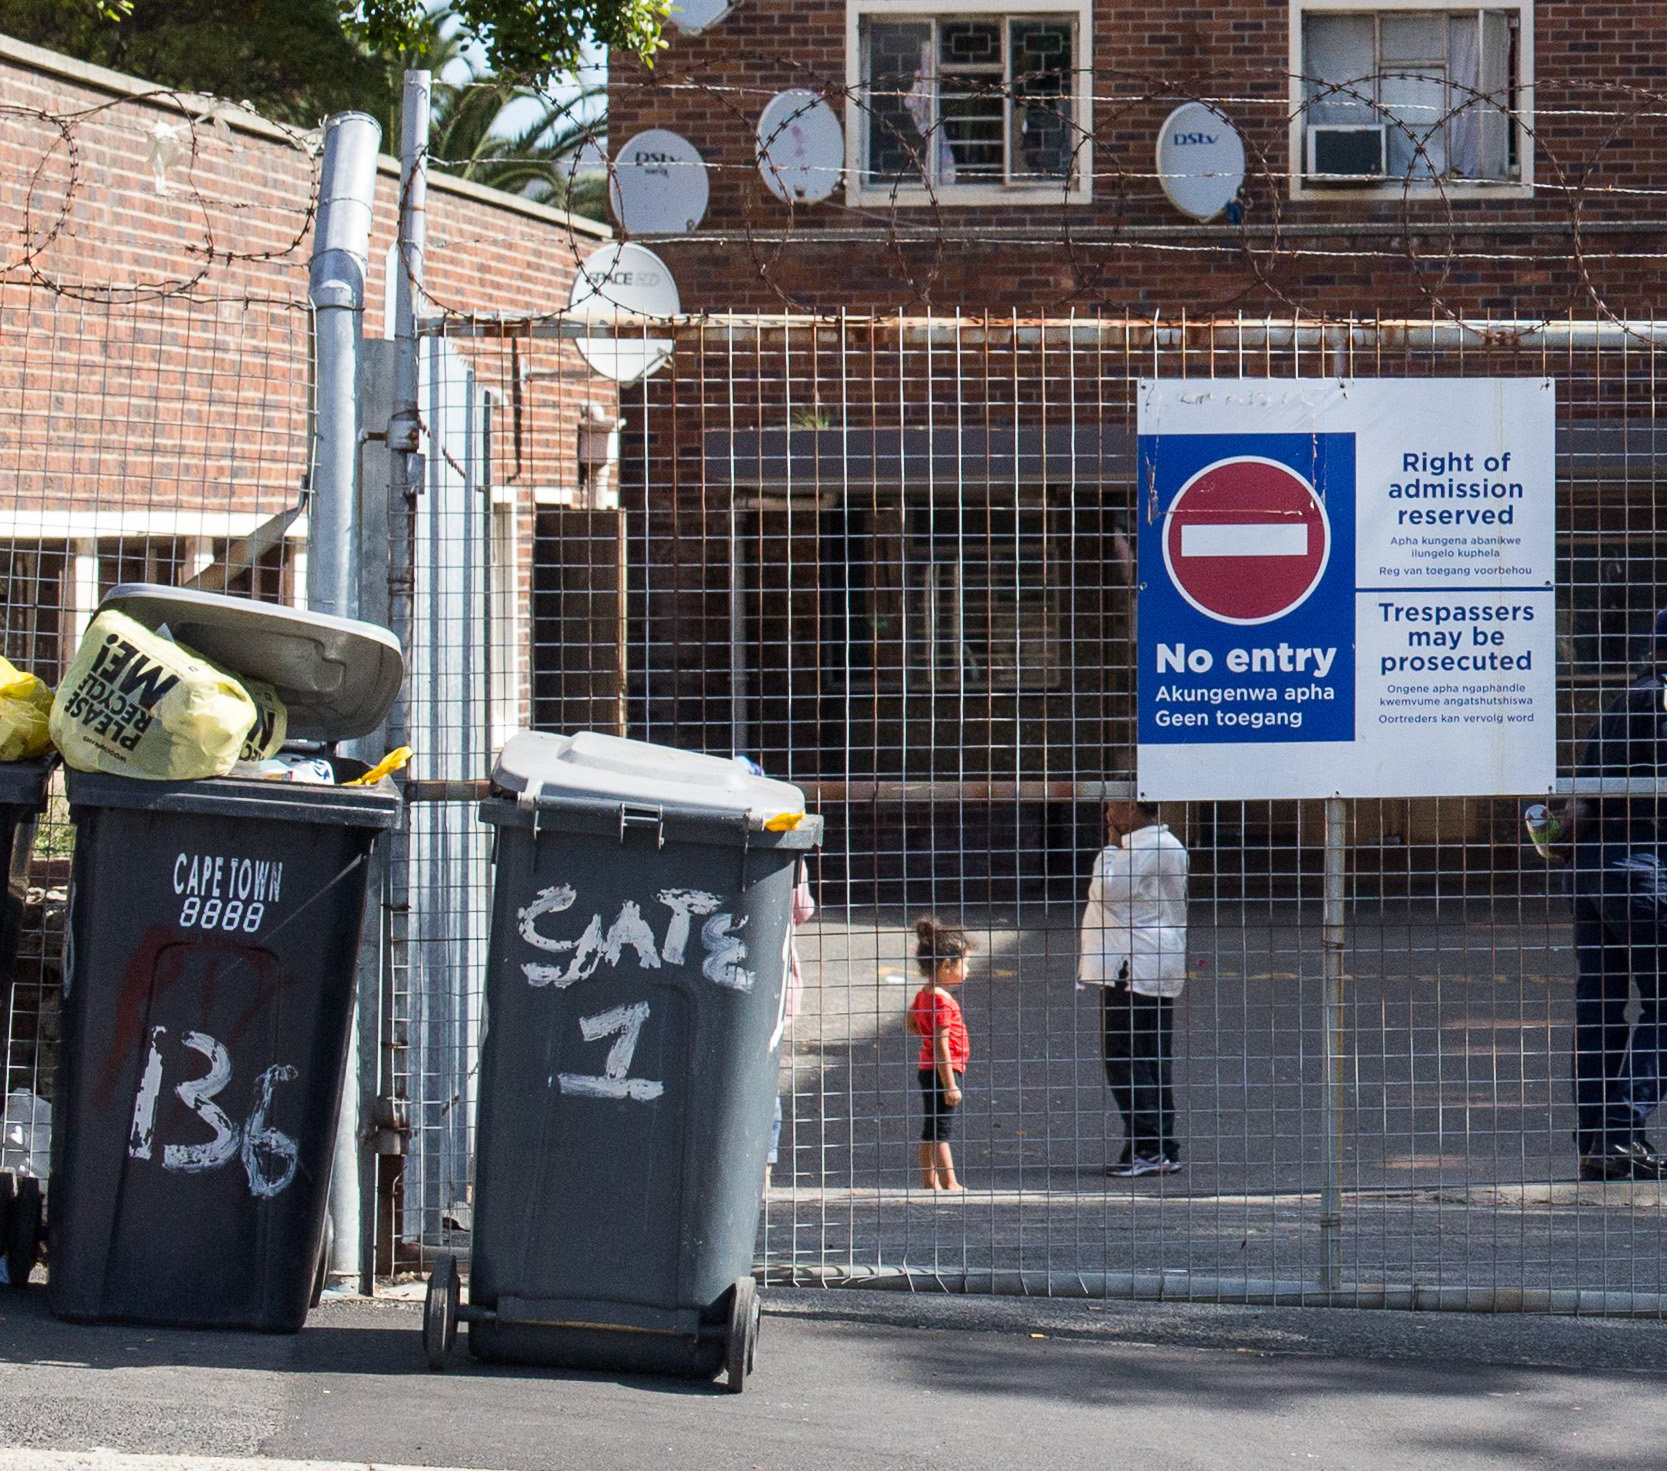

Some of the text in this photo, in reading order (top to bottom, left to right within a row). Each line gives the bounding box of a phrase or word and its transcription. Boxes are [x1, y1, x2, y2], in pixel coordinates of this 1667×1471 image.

[1403, 452, 1511, 476] Right of
[1388, 478, 1523, 499] admission
[1397, 504, 1514, 525] reserved
[1390, 535, 1522, 547] Apha kungena abanikwe
[1457, 548, 1500, 558] kuphela
[1379, 566, 1400, 577] Reg
[1425, 566, 1471, 577] toegang
[1473, 565, 1532, 575] voorbehou
[1379, 602, 1535, 625] Trespassers
[1408, 626, 1505, 650] may be
[1157, 643, 1337, 678] No entry
[1381, 650, 1532, 676] prosecuted
[91, 633, 180, 711] ME!
[1155, 683, 1335, 705] Akungenwa apha
[1387, 683, 1526, 695] Ongene apha ngaphandle
[1379, 696, 1533, 707] kwemvume angatshutshiswa
[1155, 710, 1302, 728] Geen toegang
[1379, 713, 1534, 724] Oortreders kan vervolg word
[174, 852, 283, 902] CAPE TOWN
[179, 897, 265, 933] 8888
[517, 882, 756, 994] GATE
[557, 1000, 664, 1102] 1
